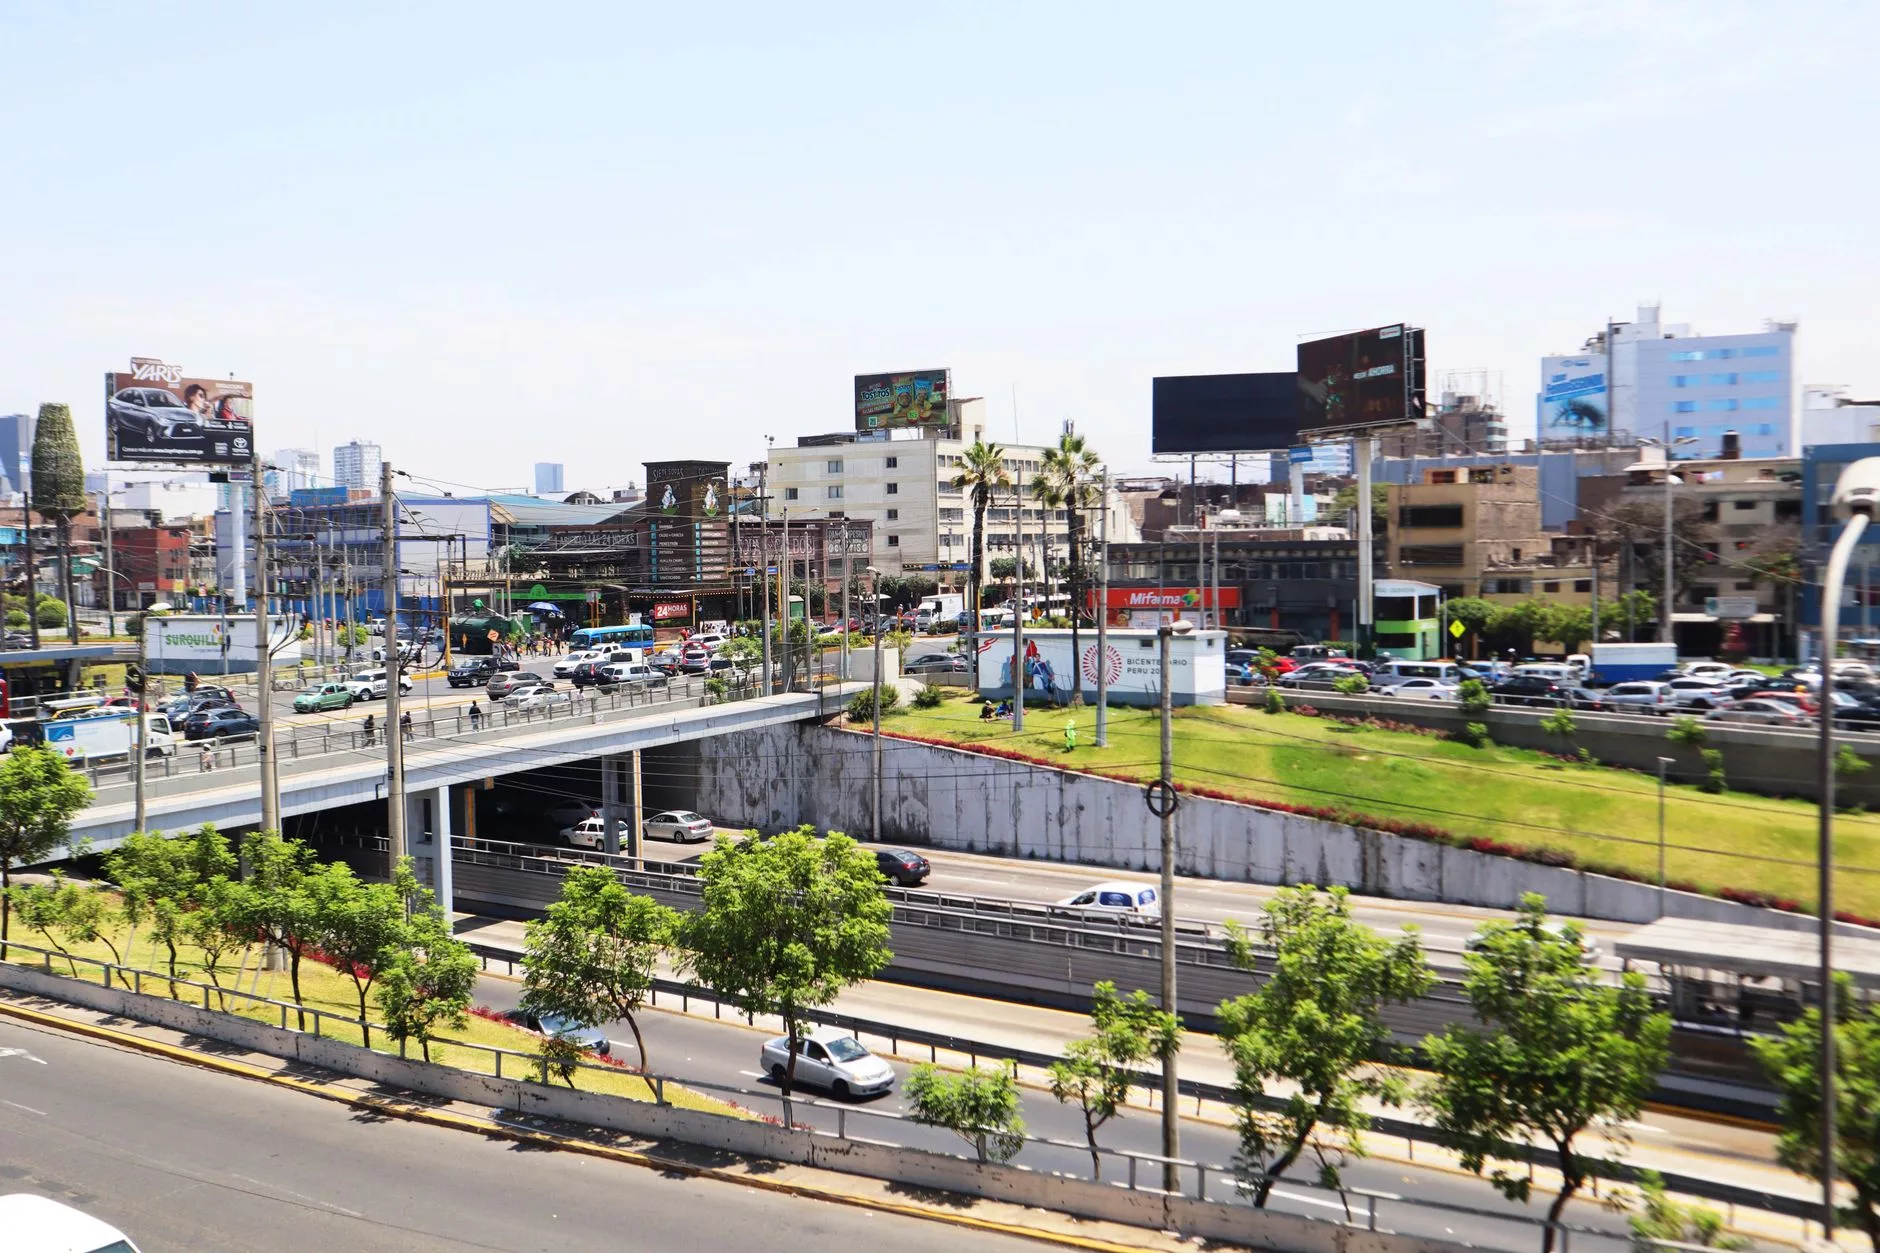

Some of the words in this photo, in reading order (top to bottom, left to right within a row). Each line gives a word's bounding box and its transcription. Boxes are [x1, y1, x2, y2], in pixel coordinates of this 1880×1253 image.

[657, 605, 668, 617] 24
[668, 604, 688, 612] HORAS
[1127, 658, 1187, 666] BICENTERIO
[1127, 667, 1148, 675] PERU
